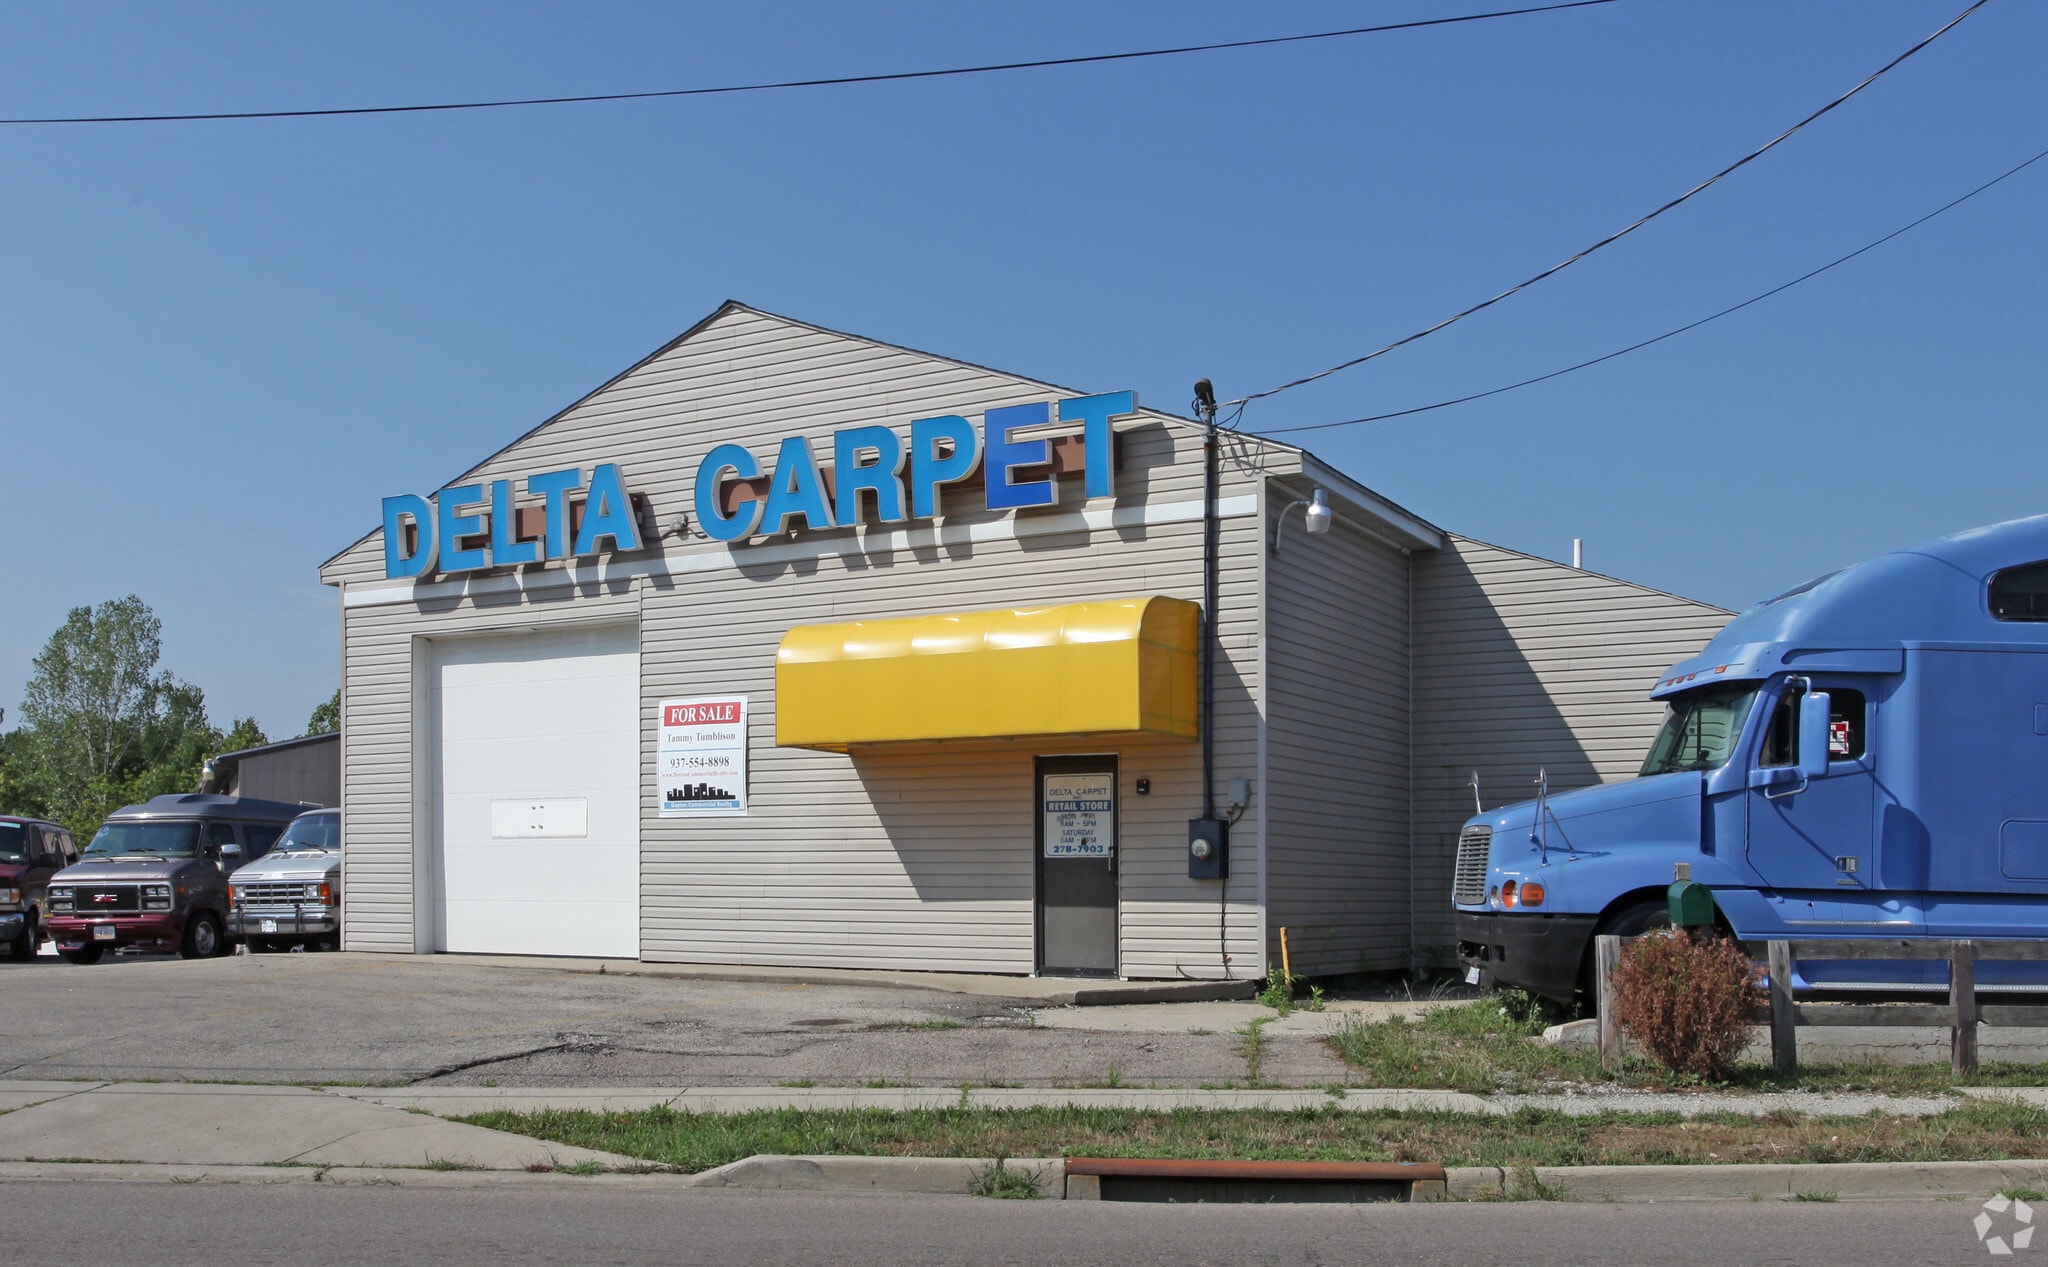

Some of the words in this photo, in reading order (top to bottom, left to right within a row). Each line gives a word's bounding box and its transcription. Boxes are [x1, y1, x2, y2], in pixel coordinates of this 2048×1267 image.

[381, 462, 643, 580] DELTA
[694, 390, 1140, 544] CARPET
[671, 707, 697, 723] FOR
[699, 705, 734, 722] SALE
[667, 733, 693, 744] Tammy
[696, 731, 736, 742] Tumblison
[1830, 731, 1845, 742] LE
[670, 756, 730, 768] 937-554-8898
[1049, 788, 1073, 796] DELTA
[1076, 787, 1107, 795] CARPET
[1048, 802, 1078, 811] RETAIL
[1080, 801, 1109, 810] STORE
[1054, 845, 1104, 853] 278-7903
